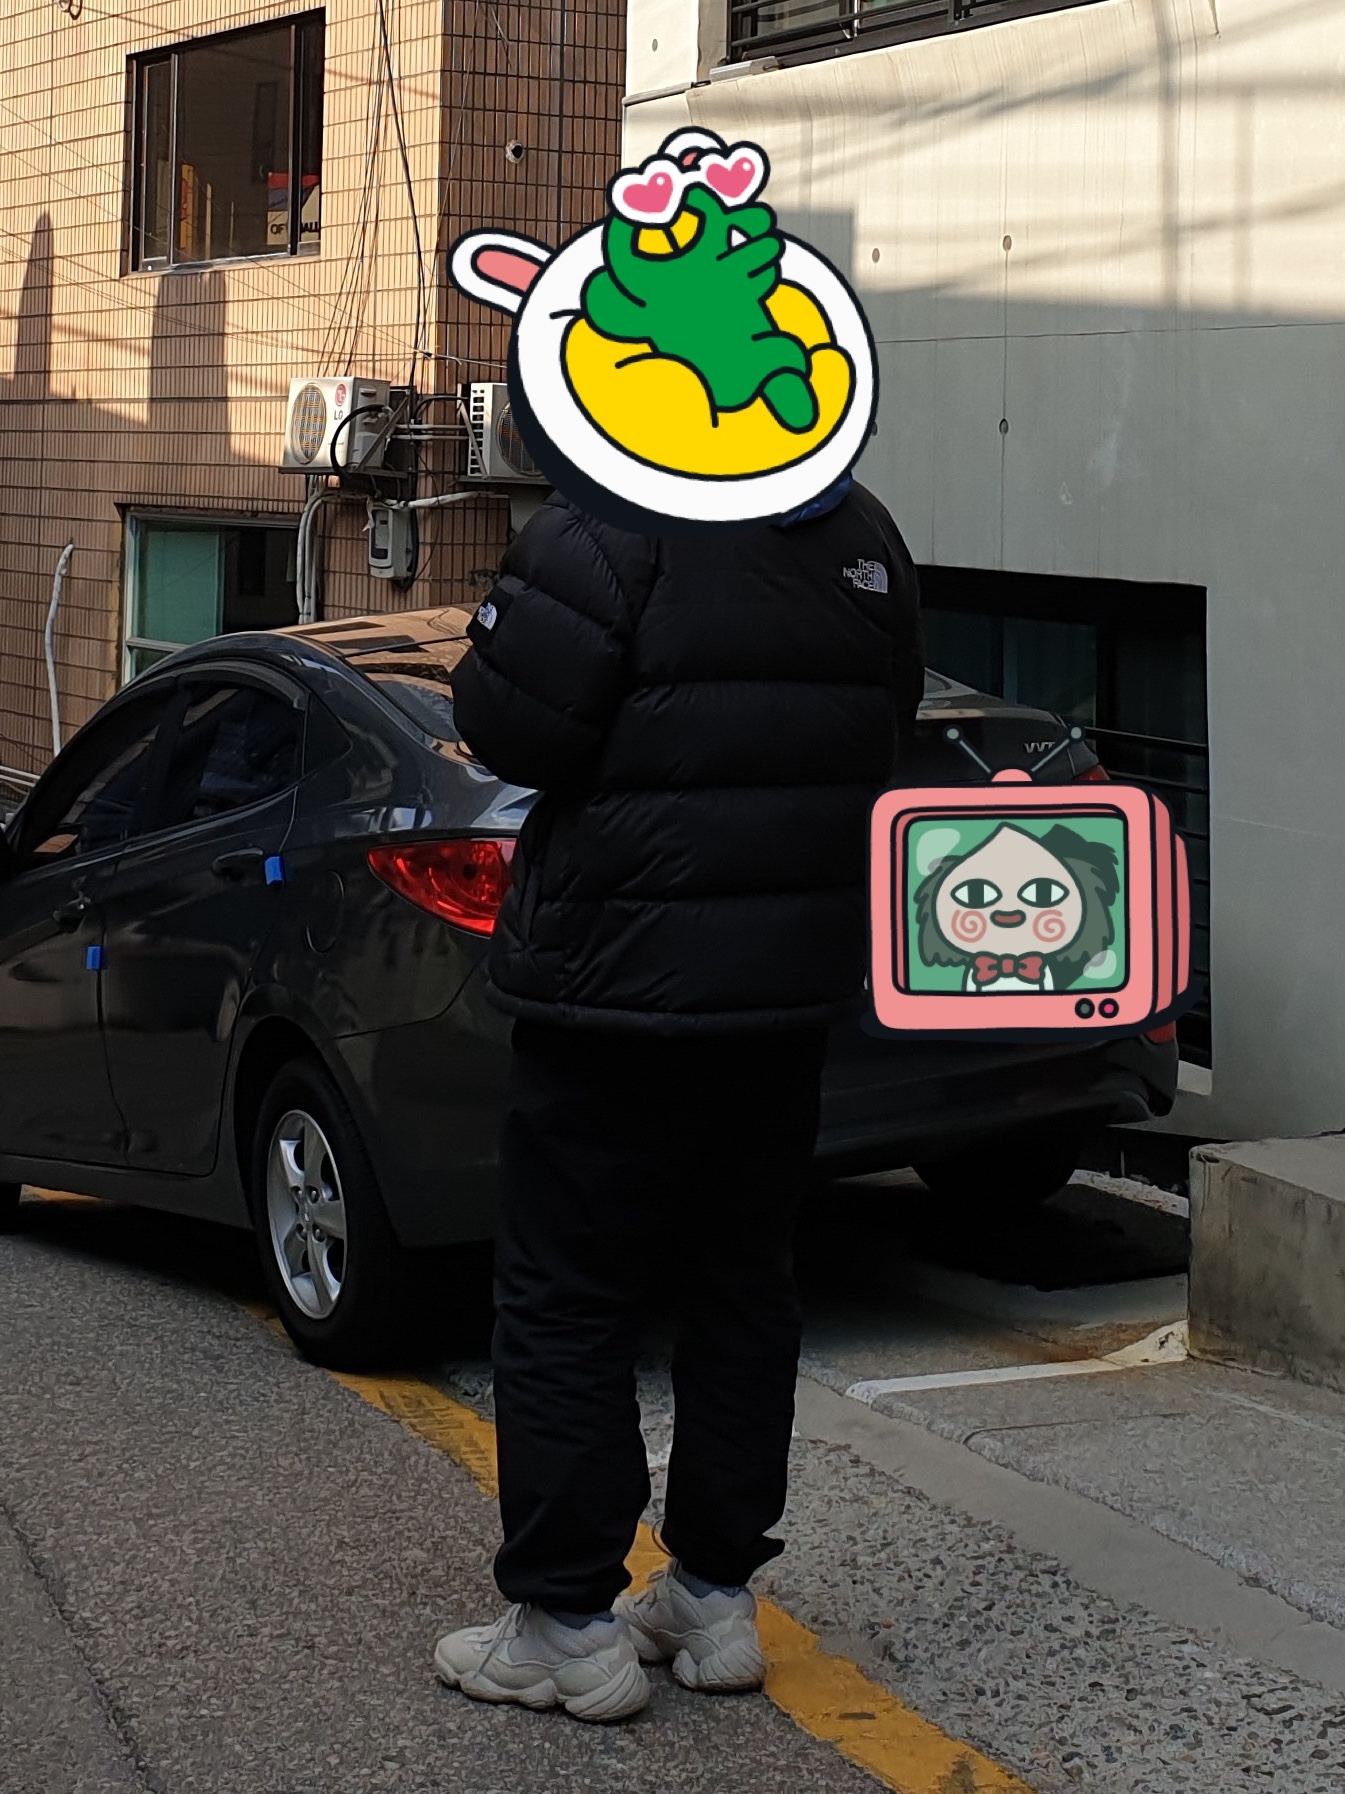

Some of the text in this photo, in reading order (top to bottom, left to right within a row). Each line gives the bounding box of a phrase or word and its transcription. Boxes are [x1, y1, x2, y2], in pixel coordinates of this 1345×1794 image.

[334, 409, 344, 421] LG
[857, 558, 875, 571] THE
[843, 566, 873, 581] NORTH
[852, 578, 875, 591] FACE
